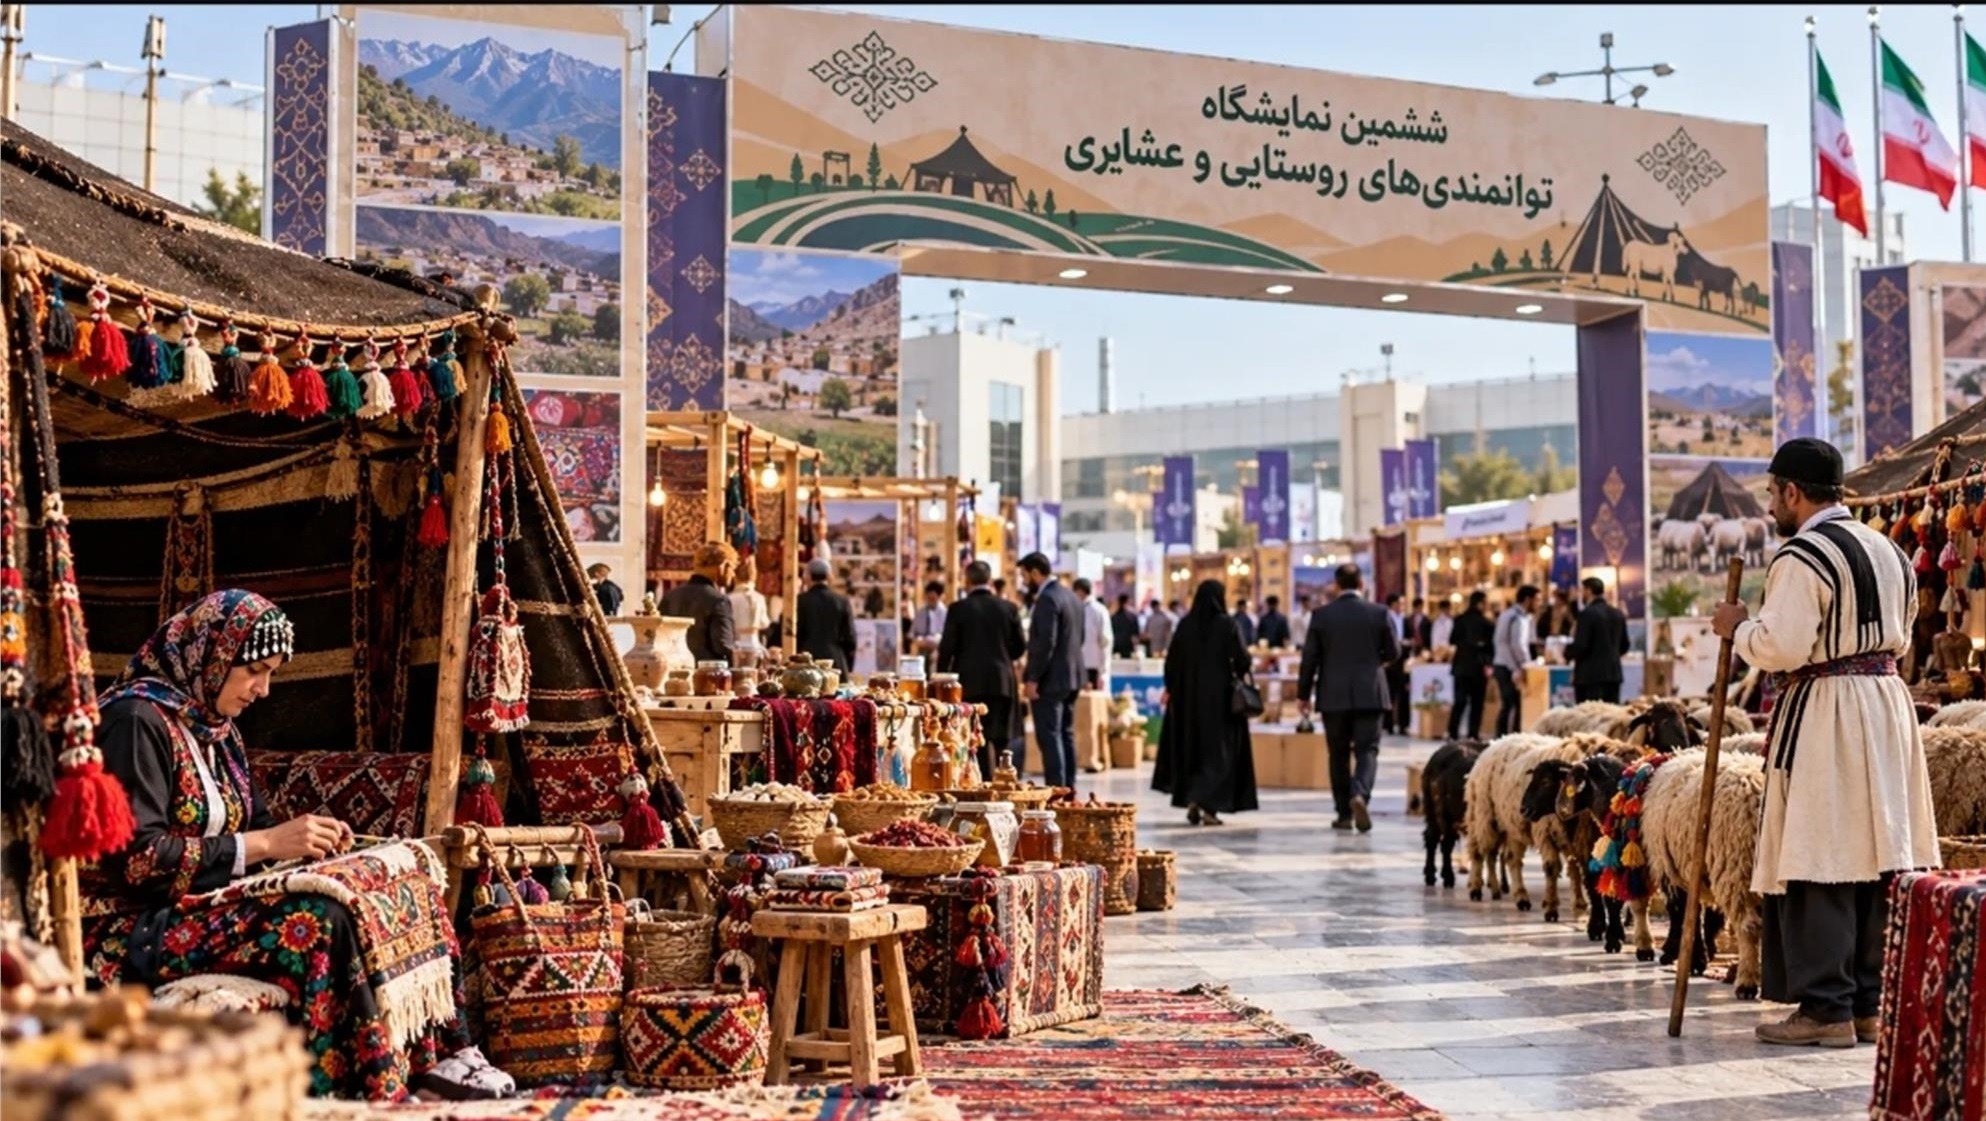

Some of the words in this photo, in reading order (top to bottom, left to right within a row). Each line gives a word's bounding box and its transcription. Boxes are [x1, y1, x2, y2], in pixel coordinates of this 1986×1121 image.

[1201, 84, 1332, 138] نمایشگاه
[1340, 112, 1448, 146] ششمین
[1064, 127, 1184, 176] عشایری
[1193, 150, 1211, 184] و
[1220, 143, 1348, 199] روستایی
